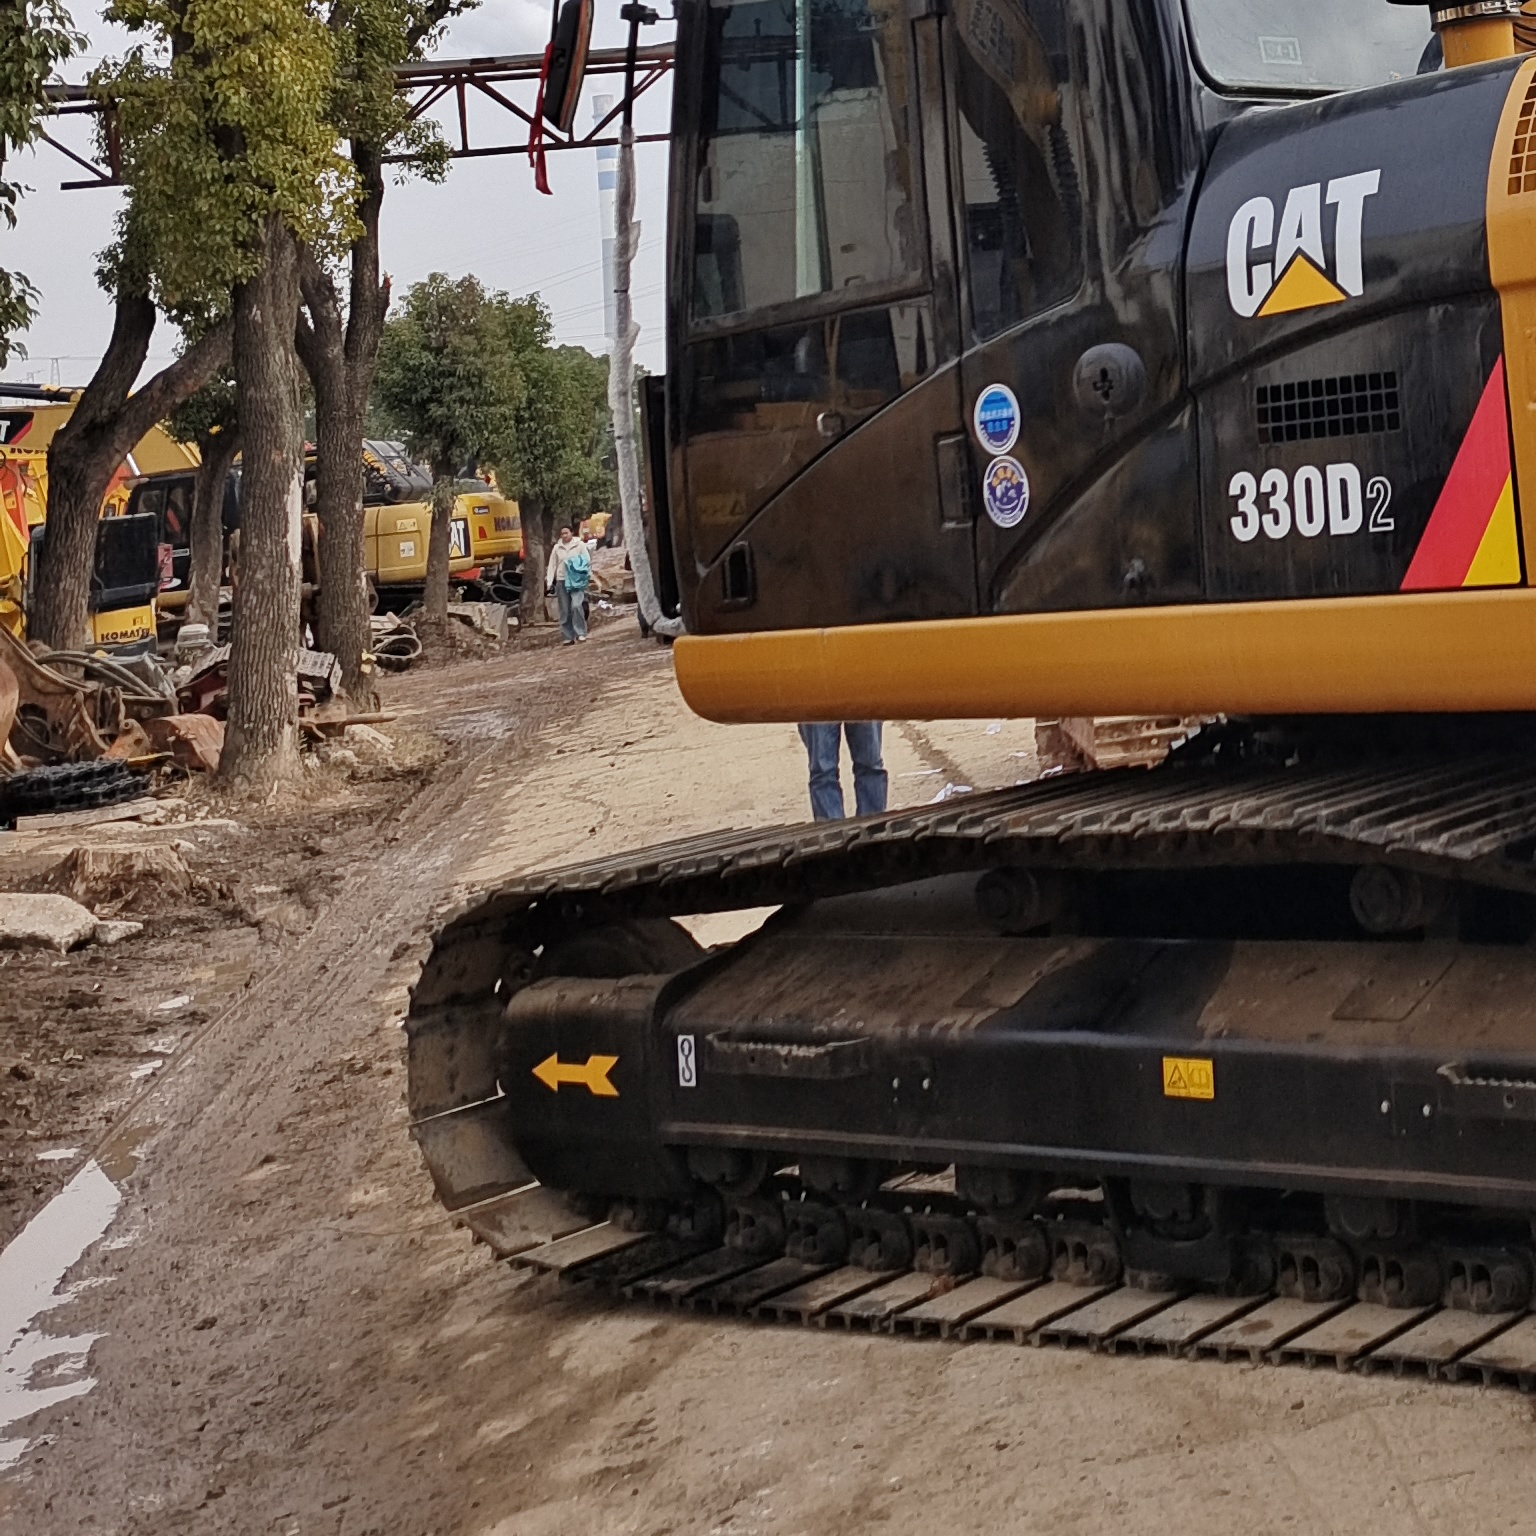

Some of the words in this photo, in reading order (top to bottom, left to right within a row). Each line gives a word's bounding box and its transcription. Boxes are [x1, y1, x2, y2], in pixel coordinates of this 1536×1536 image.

[1227, 169, 1381, 317] CAT
[449, 519, 466, 557] AT
[1228, 462, 1396, 542] 330D2
